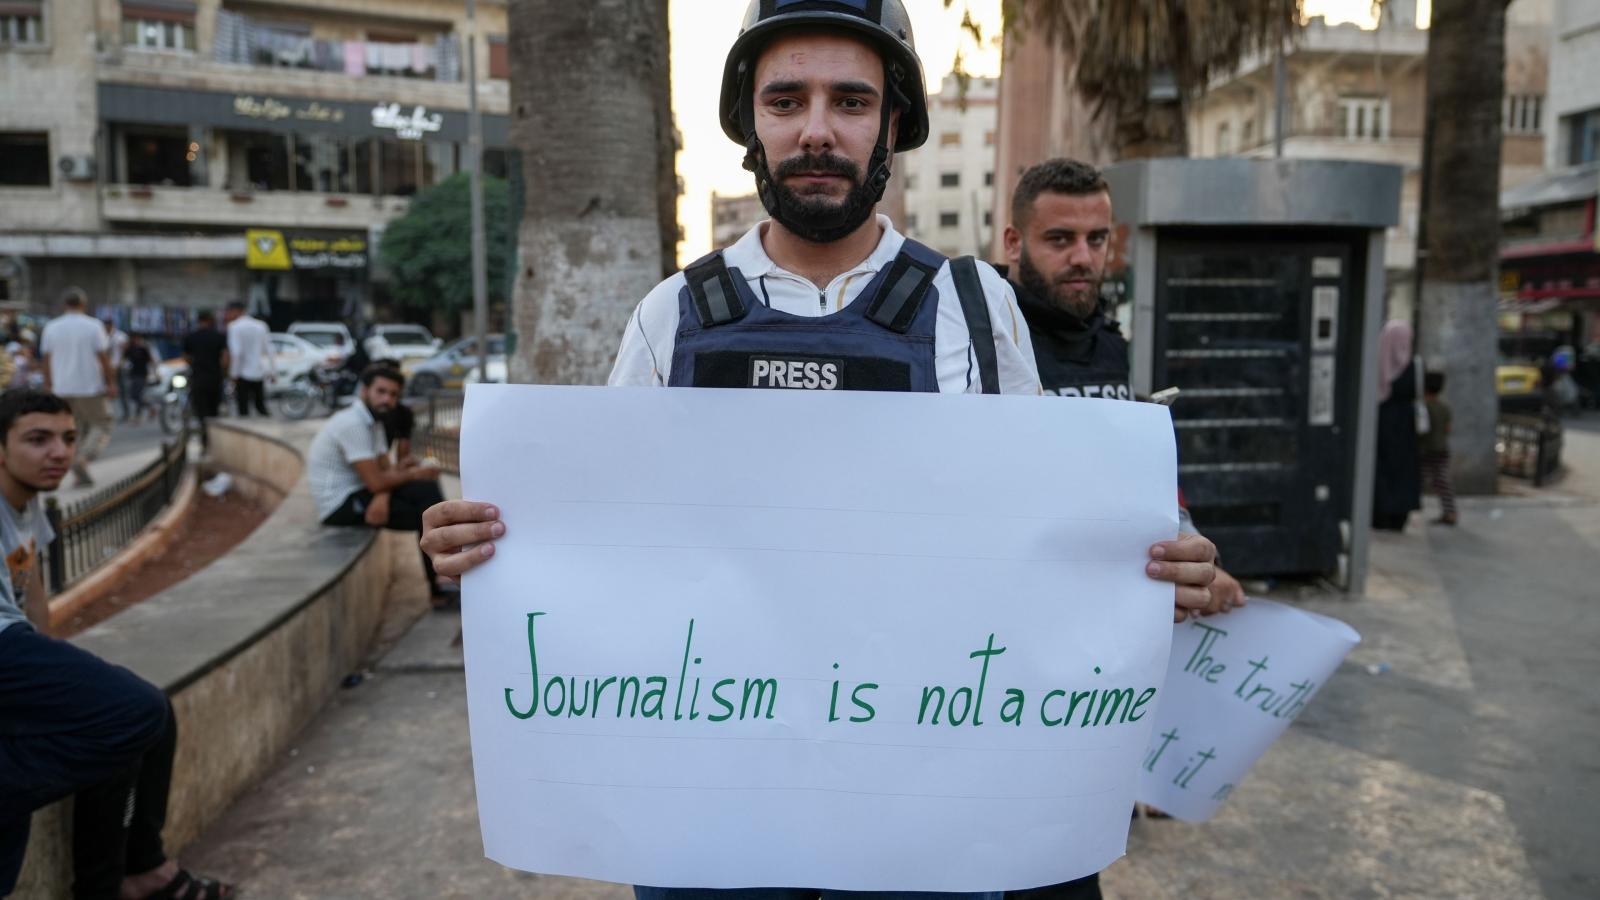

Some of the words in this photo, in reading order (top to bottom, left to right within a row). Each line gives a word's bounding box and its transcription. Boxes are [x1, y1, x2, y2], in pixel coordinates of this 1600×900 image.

[752, 359, 838, 390] PRESS
[504, 611, 778, 722] Journalism
[828, 662, 879, 723] is
[917, 632, 1007, 727] not
[999, 687, 1025, 727] a
[1040, 665, 1157, 729] crime
[1183, 621, 1228, 683] The
